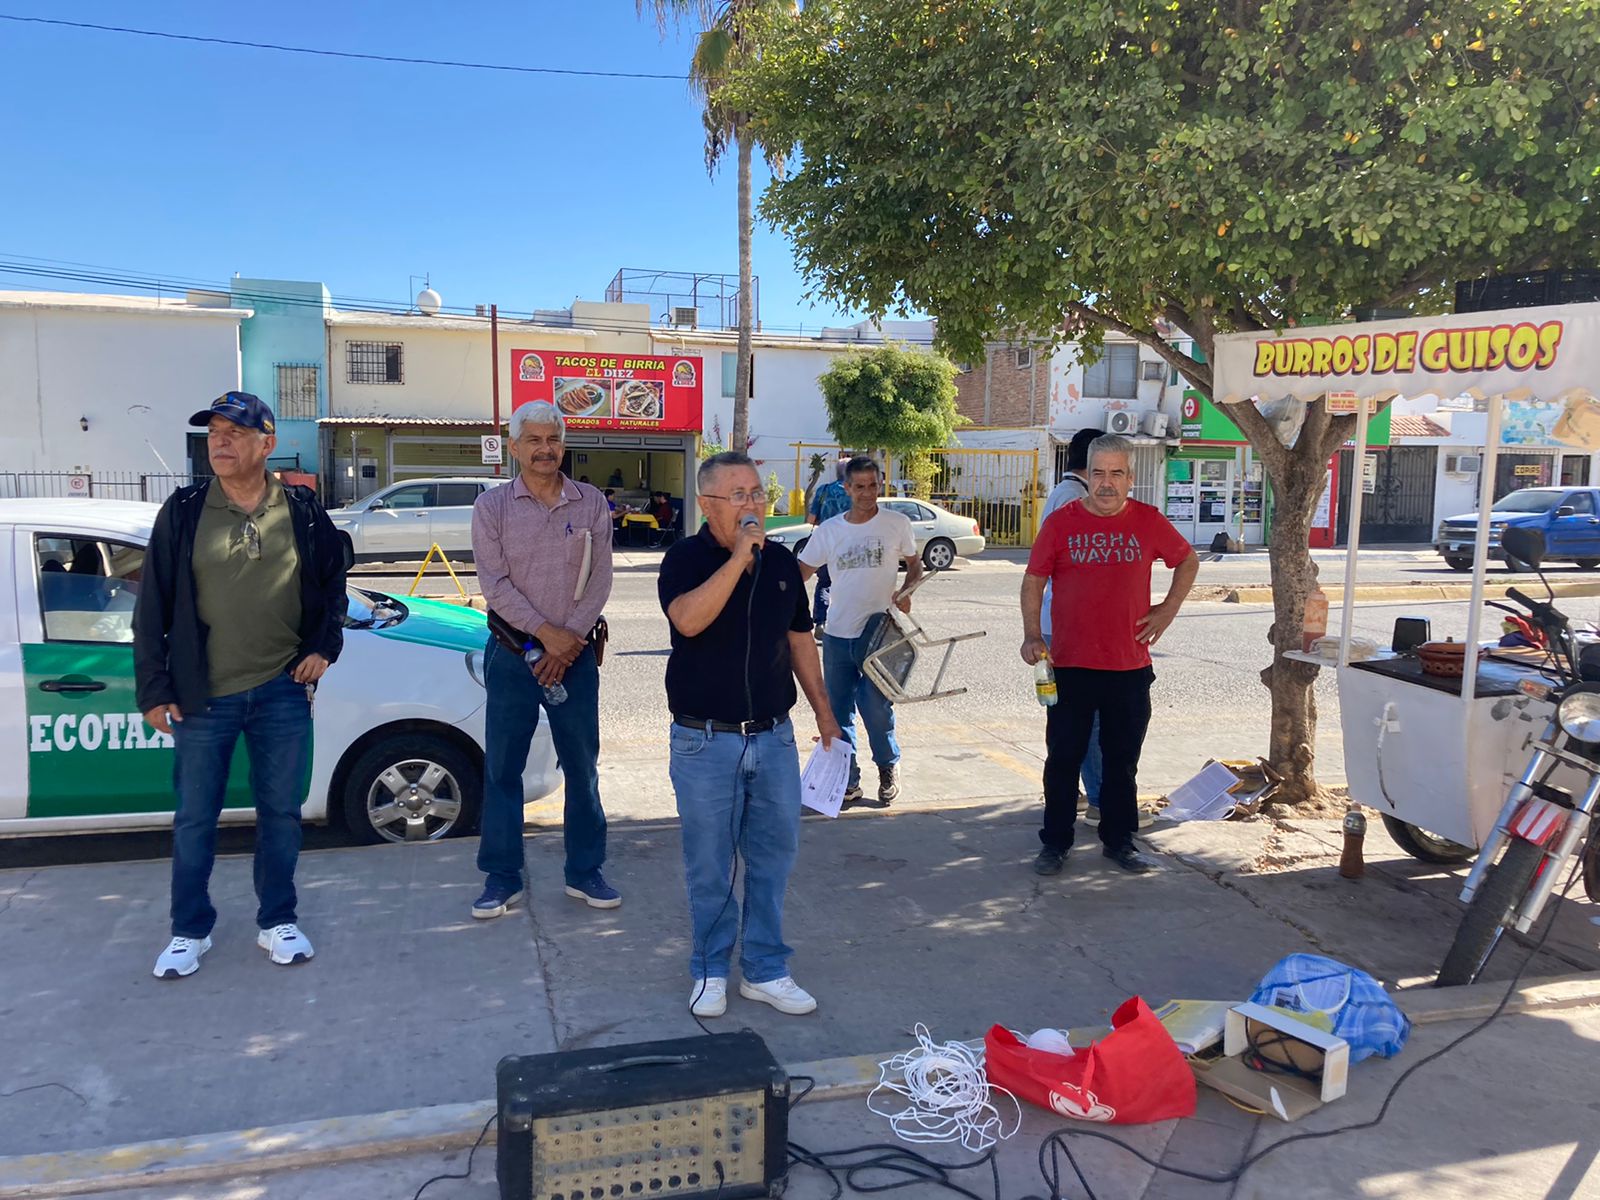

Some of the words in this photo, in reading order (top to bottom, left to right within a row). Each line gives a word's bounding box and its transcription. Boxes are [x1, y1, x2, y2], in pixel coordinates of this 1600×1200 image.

[1254, 335, 1370, 377] BURROS
[1371, 331, 1418, 373] DE
[1421, 320, 1563, 373] GUISOS
[555, 356, 596, 367] TACOS
[600, 358, 617, 368] DE
[624, 359, 666, 370] BIRRIA
[585, 368, 601, 377] EL
[603, 368, 634, 378] DIEZ
